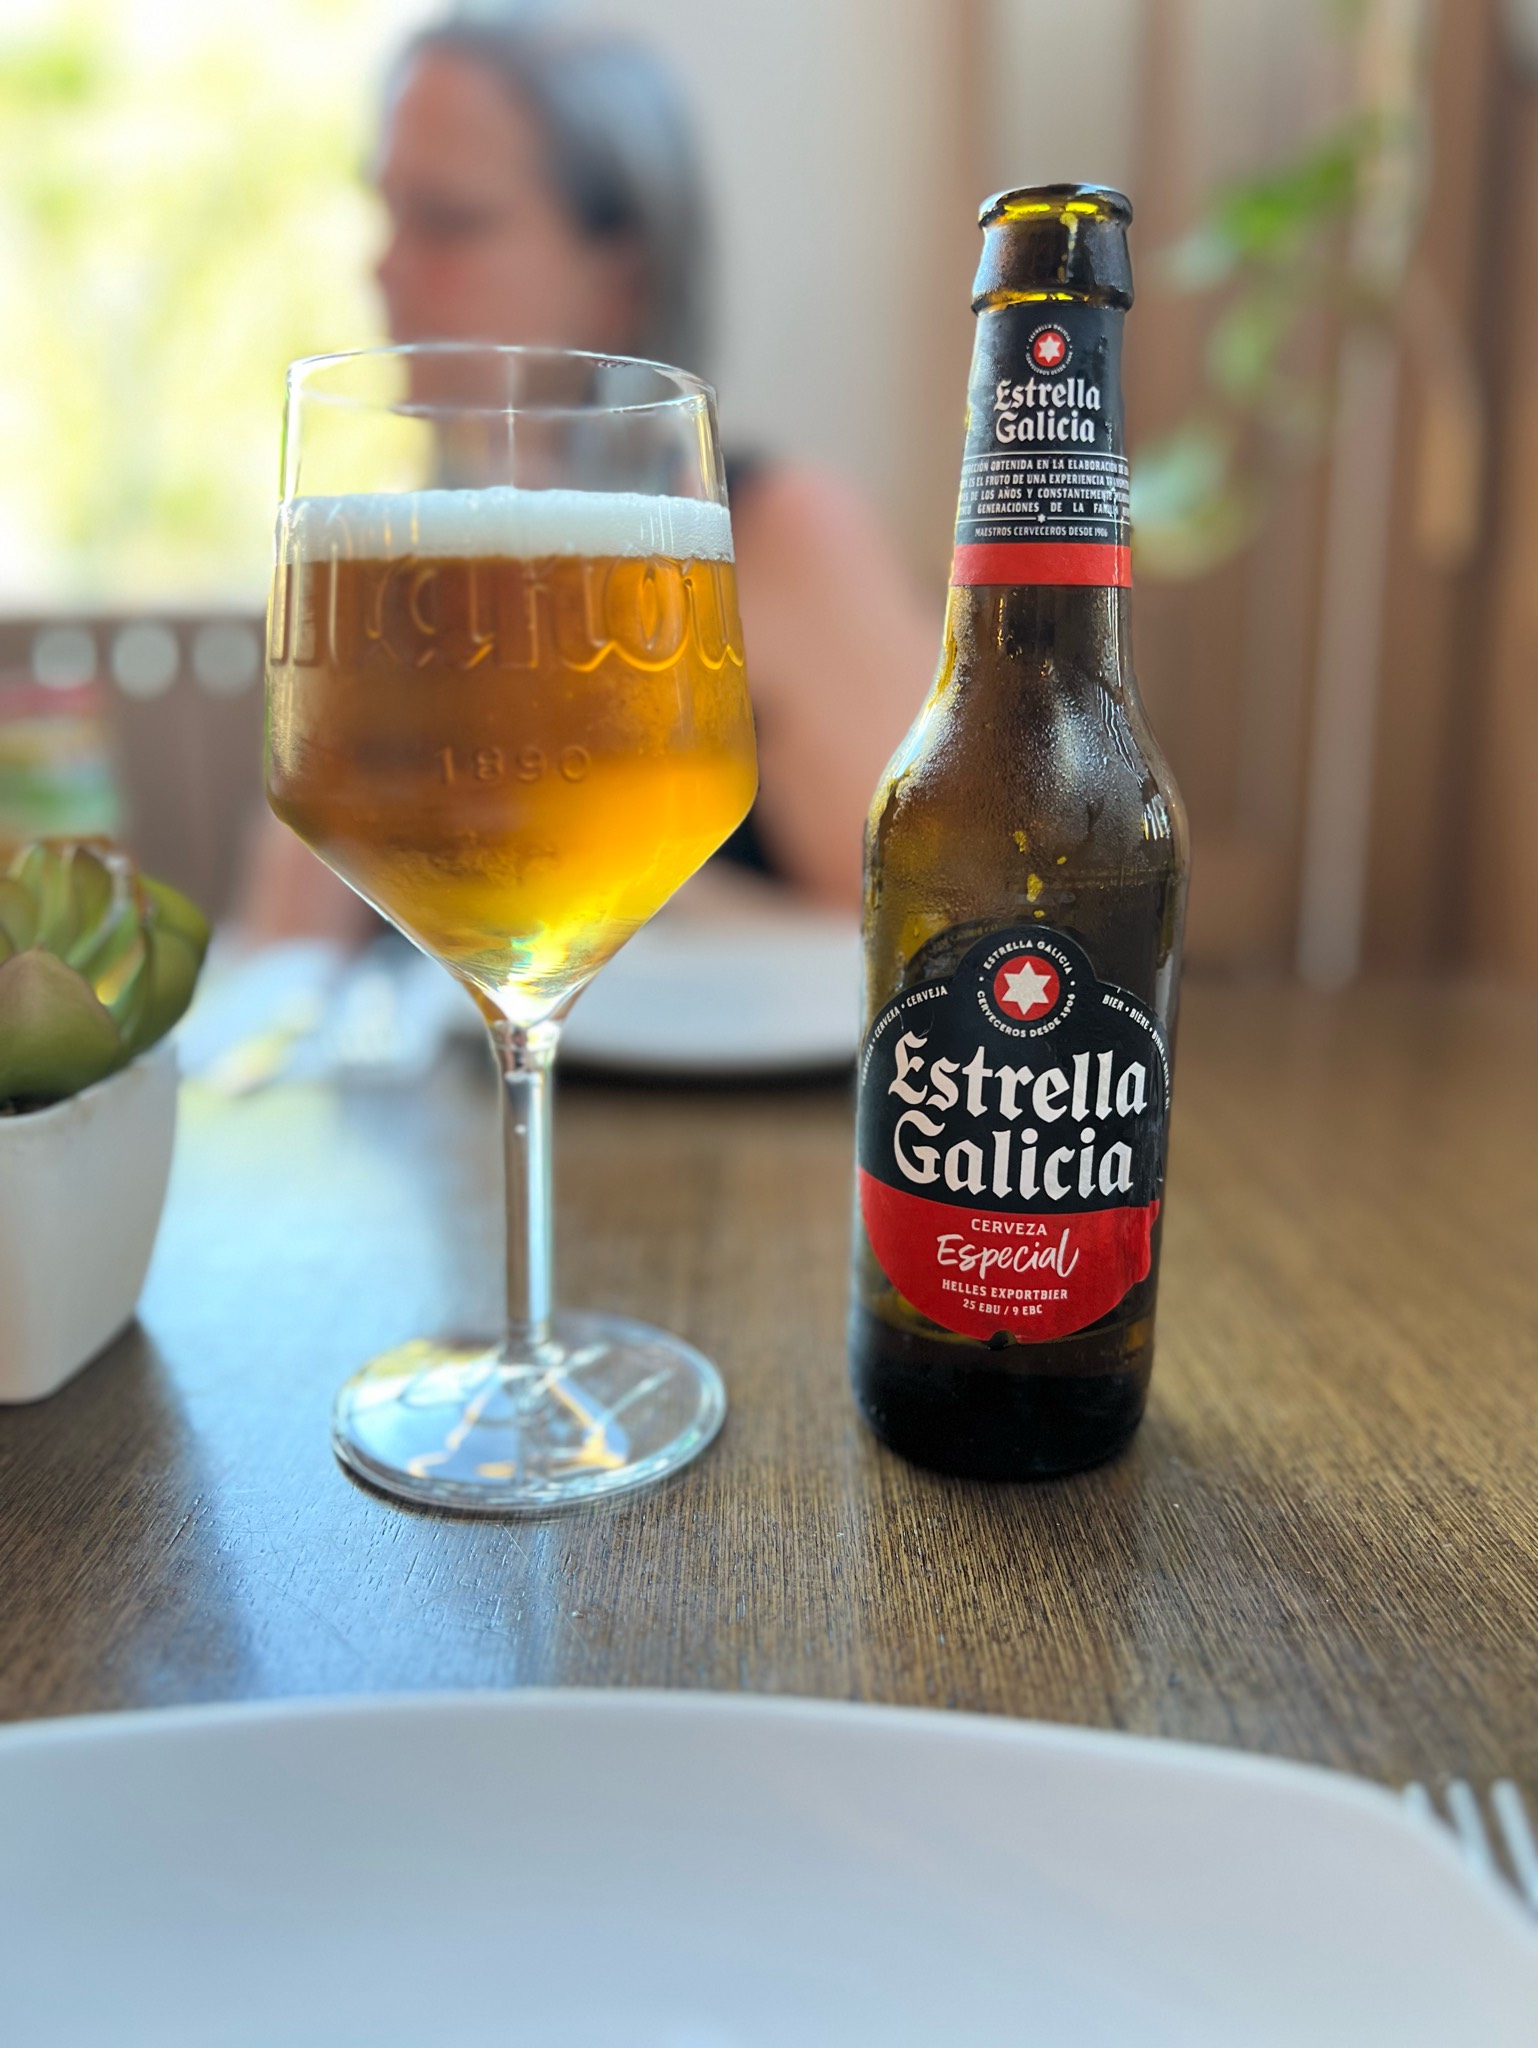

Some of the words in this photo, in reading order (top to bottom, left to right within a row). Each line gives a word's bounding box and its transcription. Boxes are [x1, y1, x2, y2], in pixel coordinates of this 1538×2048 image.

[993, 377, 1101, 411] Estrella
[995, 410, 1096, 443] Galicia
[976, 477, 983, 486] EL
[985, 475, 1010, 486] FRUTO
[1012, 474, 1024, 485] DE
[1027, 474, 1046, 484] UNA
[1049, 473, 1104, 485] EXPERIENCIA
[990, 461, 1032, 471] OBTENIDA
[1036, 460, 1050, 470] EN
[1052, 459, 1064, 470] LA
[1069, 460, 1117, 472] ELABORACIÓN
[977, 502, 1040, 514] GENERACIONES
[1050, 502, 1062, 513] DE
[1072, 503, 1084, 513] LA
[981, 490, 994, 500] LOS
[998, 487, 1022, 499] AÑOS
[1027, 488, 1032, 498] Y
[1037, 488, 1112, 500] CONSTANTEMENTE
[974, 526, 1011, 537] MAESTROS
[1013, 526, 1067, 536] CERVECEROS
[1068, 526, 1093, 536] DESDE
[1095, 526, 1108, 537] 1906
[434, 744, 592, 786] 1890
[983, 939, 1034, 970] ESTRELLA
[1036, 940, 1073, 975] GALICIA
[874, 1005, 901, 1038] CERVEXA
[906, 985, 949, 1008] CERVEJA
[976, 990, 1027, 1038] CERVECEROS
[1029, 1016, 1062, 1038] DESDE
[1060, 993, 1076, 1018] 1906
[1101, 994, 1125, 1012] BIER
[1129, 1007, 1151, 1031] BIÈRE
[888, 1030, 1149, 1123] Estrella
[893, 1110, 1135, 1200] Galicia
[971, 1217, 1048, 1237] CERVEZA
[936, 1227, 1079, 1279] Especial
[941, 1278, 987, 1297] HELLES
[990, 1287, 1068, 1300] EXPORTBIER
[962, 1298, 976, 1311] 25
[978, 1302, 1001, 1315] EBU
[1003, 1305, 1009, 1315] /
[1012, 1304, 1019, 1316] 9
[1022, 1304, 1043, 1316] EBC
